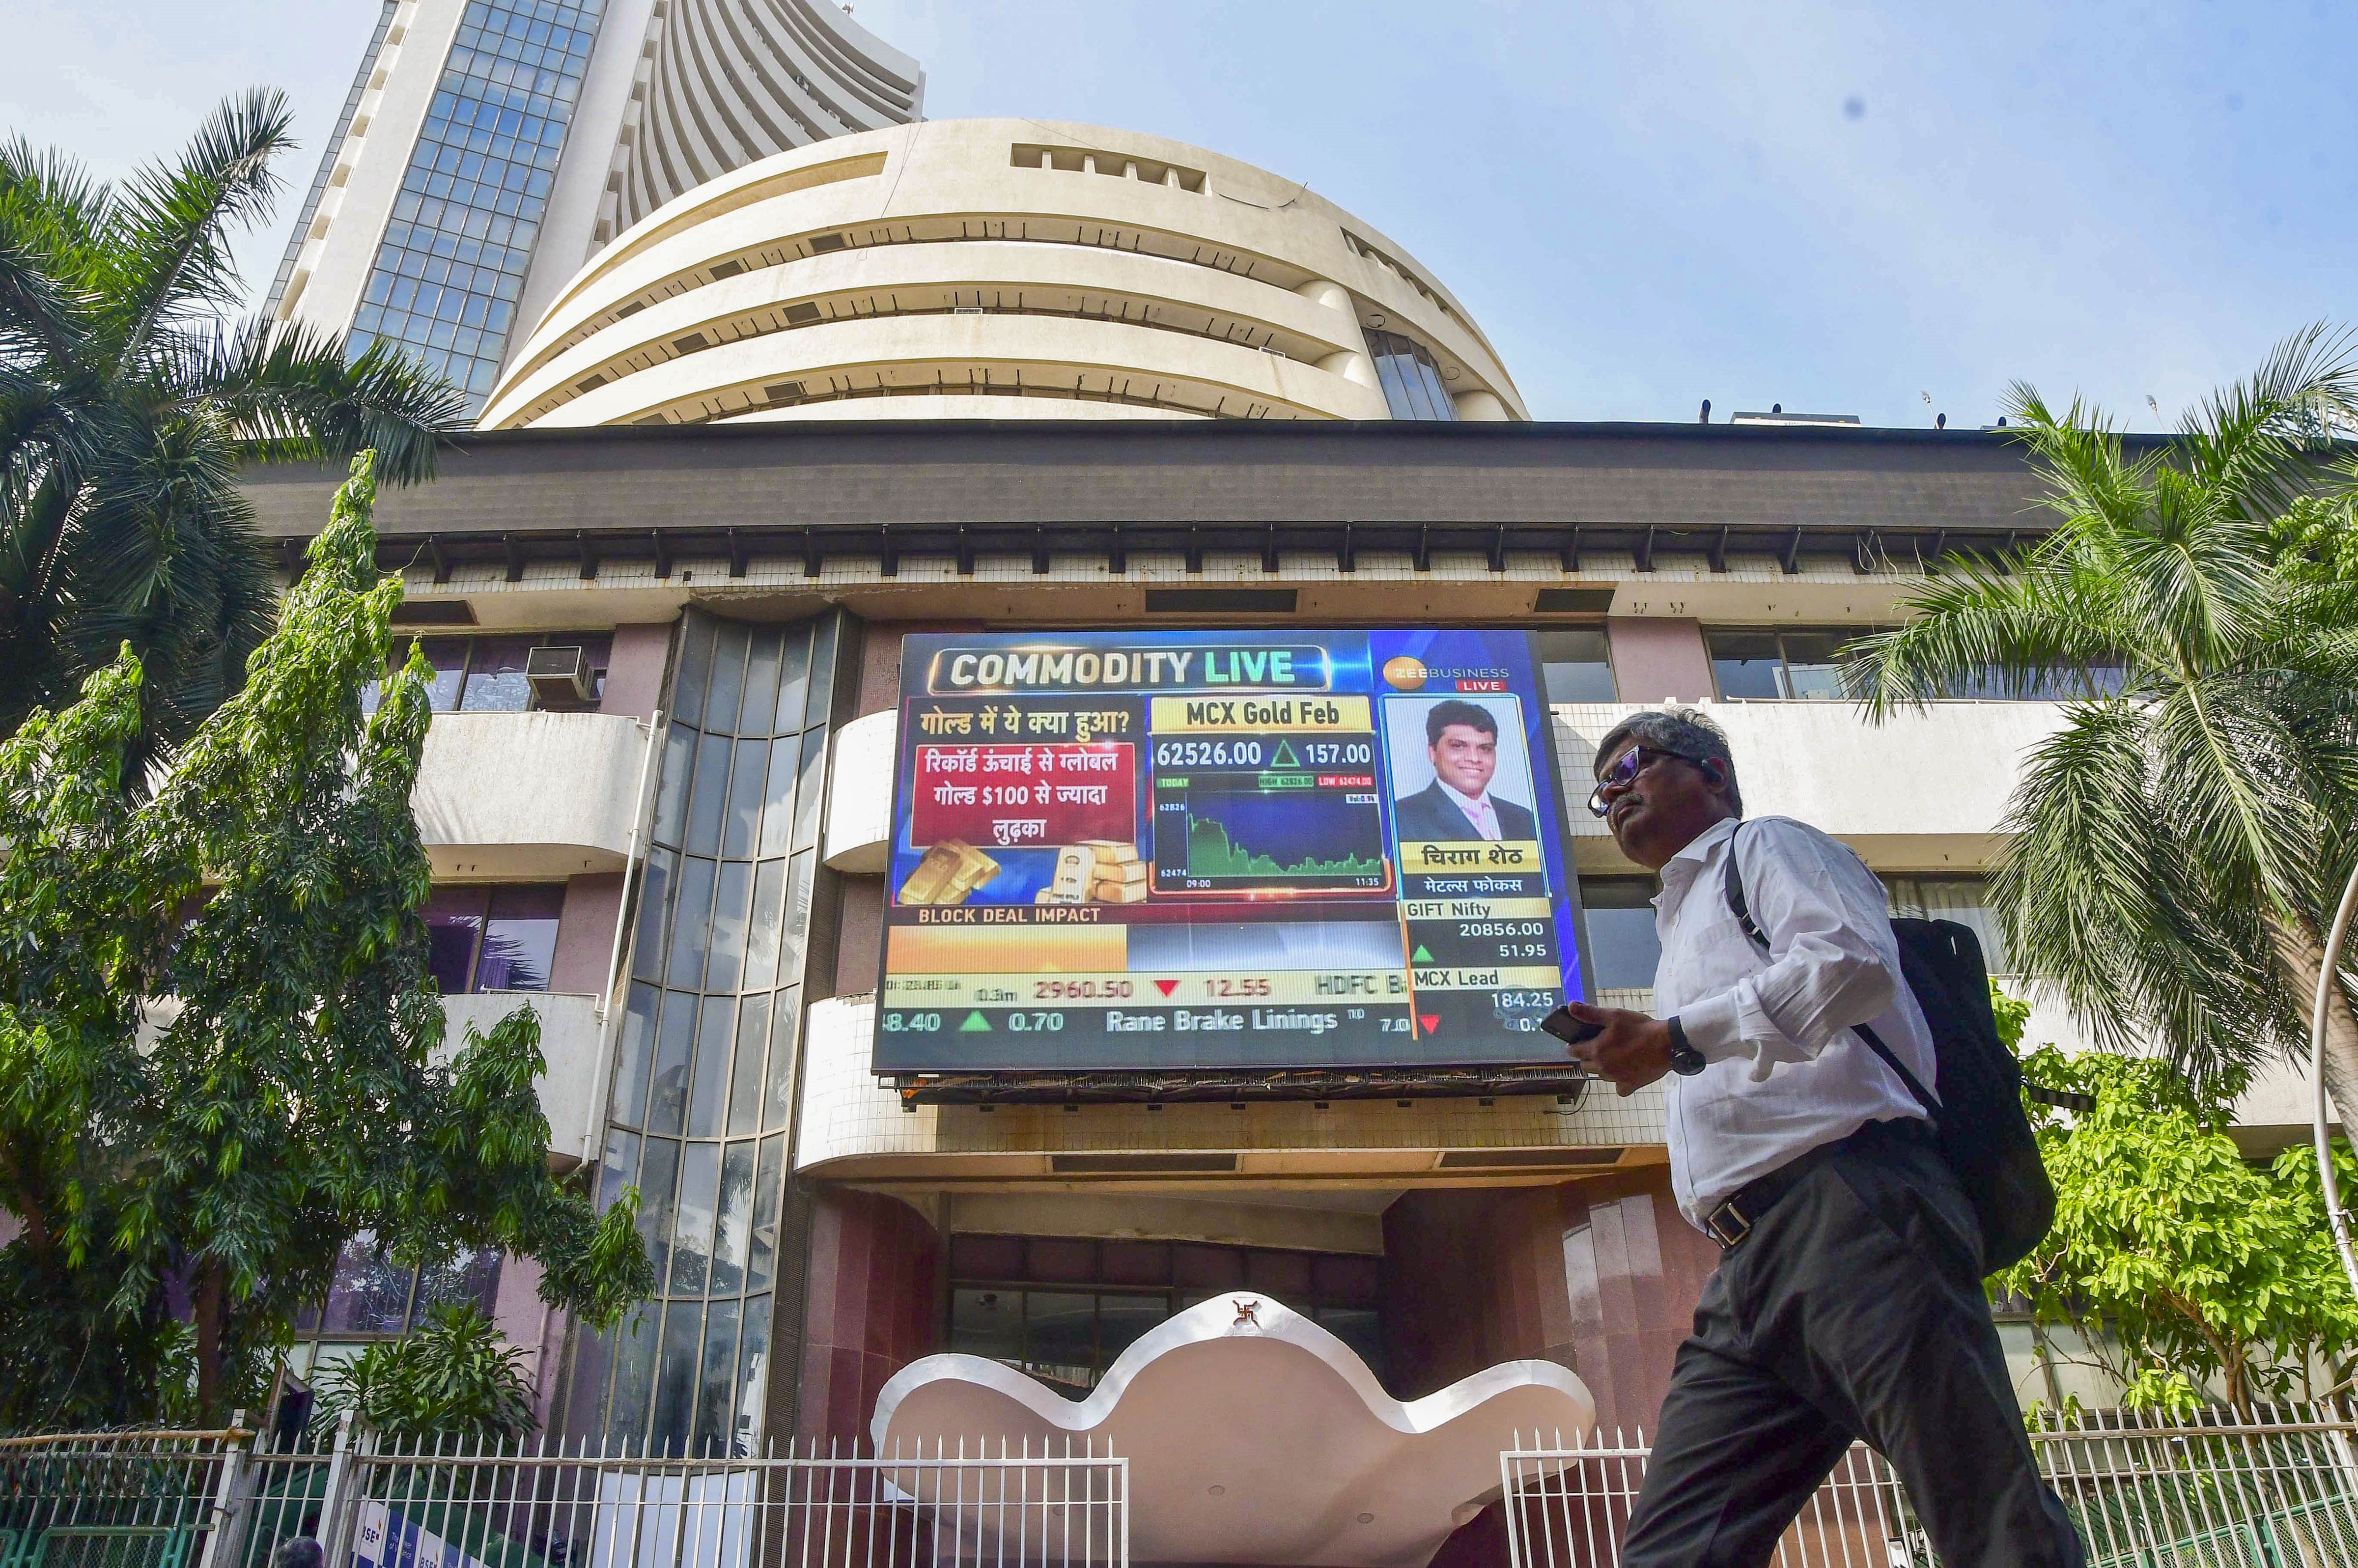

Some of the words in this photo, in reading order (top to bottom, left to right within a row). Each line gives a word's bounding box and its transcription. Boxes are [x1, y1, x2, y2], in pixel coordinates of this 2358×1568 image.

[951, 651, 1192, 684] COMMODITY
[1205, 651, 1295, 682] LIVE
[1463, 681, 1501, 691] LIVE
[1187, 702, 1236, 725] MCX
[1244, 701, 1291, 725] Gold
[1300, 701, 1339, 725] Feb
[920, 705, 973, 734] गोल्ड
[979, 705, 998, 734] में
[1003, 705, 1021, 734] ये
[1027, 711, 1069, 734] क्या
[1074, 710, 1129, 743] हुआ?
[925, 748, 979, 773] रिकॉर्ड
[982, 747, 1033, 775] ऊंचाई
[1038, 748, 1055, 772] से
[1059, 747, 1118, 772] ग्लोबल
[1157, 741, 1262, 766] 62526.00
[1306, 743, 1371, 764] 157.00
[1319, 777, 1336, 785] LOW
[933, 781, 978, 805] गोल्ड
[982, 785, 1028, 807] $100
[1034, 780, 1051, 805] से
[1057, 785, 1108, 805] ज्यादा
[992, 819, 1047, 845] लुढ़का
[1421, 844, 1480, 865] चिराग
[1488, 844, 1523, 864] शेठ
[1161, 869, 1187, 877] 62474
[1355, 878, 1379, 886] 11:35
[1424, 876, 1468, 893] मेटल्स
[1472, 875, 1522, 893] फोकस
[919, 908, 976, 923] BLOCK
[983, 908, 1028, 923] DEAL
[1035, 907, 1100, 923] IMPACT
[1407, 903, 1444, 916] GIFT
[1451, 902, 1490, 919] Nifty
[1460, 922, 1544, 937] 20856.00
[1499, 944, 1547, 957] 51.95
[1414, 971, 1451, 986] MCX
[1458, 969, 1499, 985] Lead
[1033, 980, 1134, 999] 2960.50
[1206, 979, 1273, 997] 12.55
[1317, 975, 1378, 995] HDFC
[1491, 992, 1553, 1008] 184.25
[1008, 1012, 1064, 1032] 0.70
[1105, 1011, 1166, 1032] Rane
[1174, 1008, 1245, 1032] Brake
[1251, 1008, 1338, 1035] Linings
